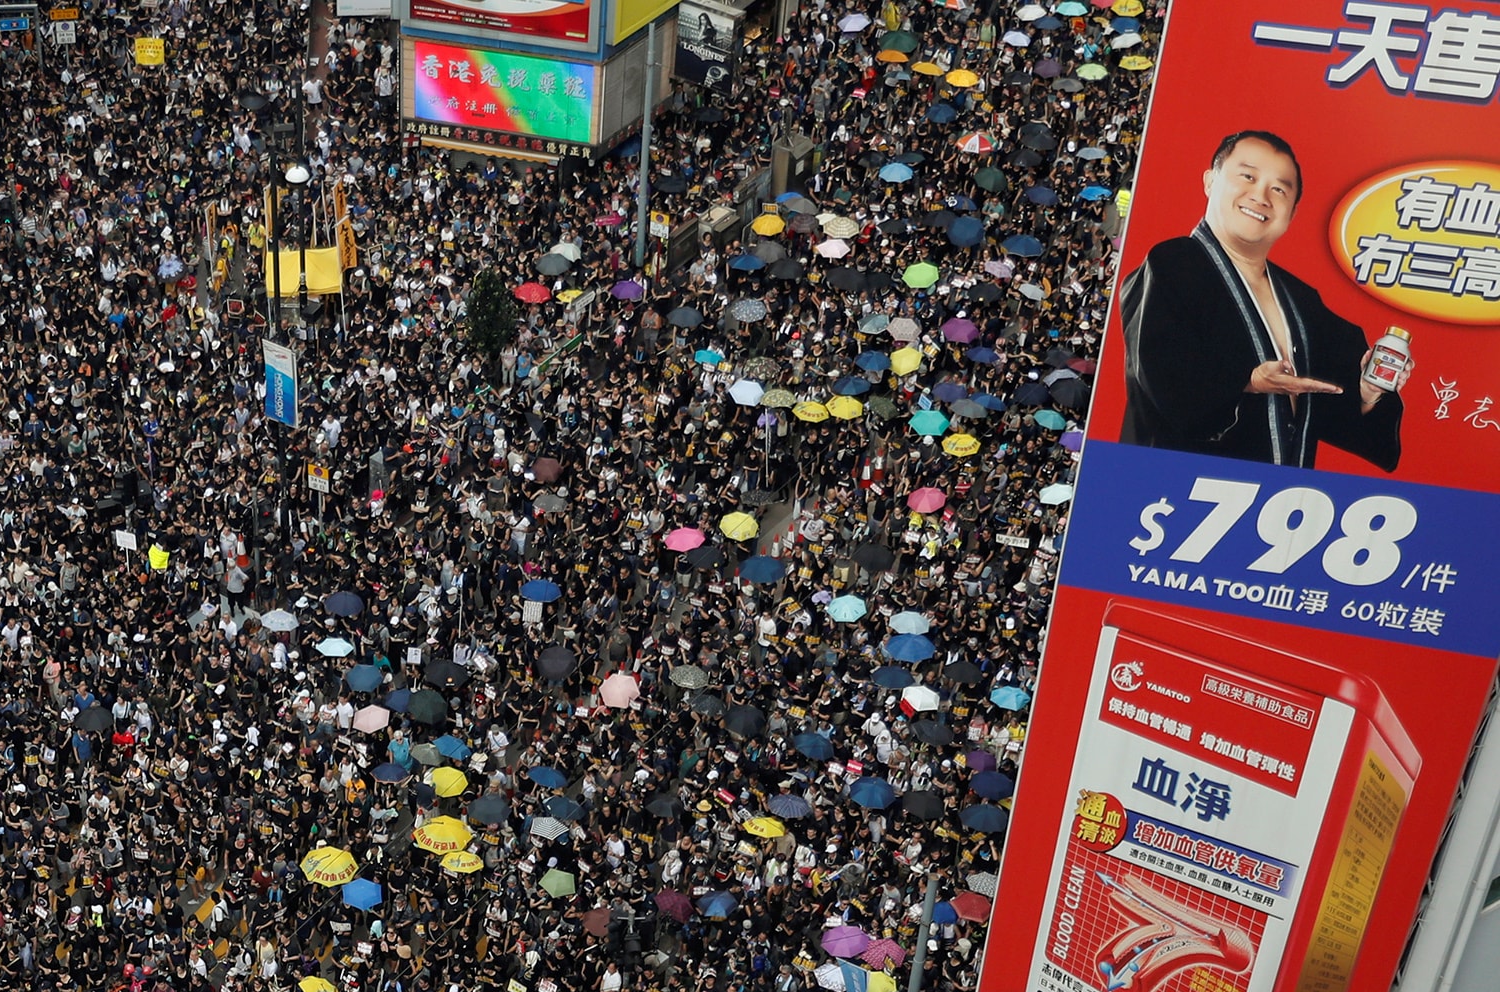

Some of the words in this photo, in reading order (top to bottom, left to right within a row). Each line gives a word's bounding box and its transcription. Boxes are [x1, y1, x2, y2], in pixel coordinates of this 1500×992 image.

[683, 42, 725, 63] LONGINES
[1253, 1, 1500, 101] 一天售
[1397, 177, 1500, 234] 有血
[1340, 600, 1446, 636] 60粒裝
[1146, 681, 1191, 703] YAMATOO
[1108, 697, 1192, 742] 保持血管暢通
[1199, 732, 1296, 782] 增加血管彈性
[1132, 756, 1234, 823] 血淨
[1053, 911, 1077, 960] BLOOD
[1066, 866, 1087, 910] CLEAN
